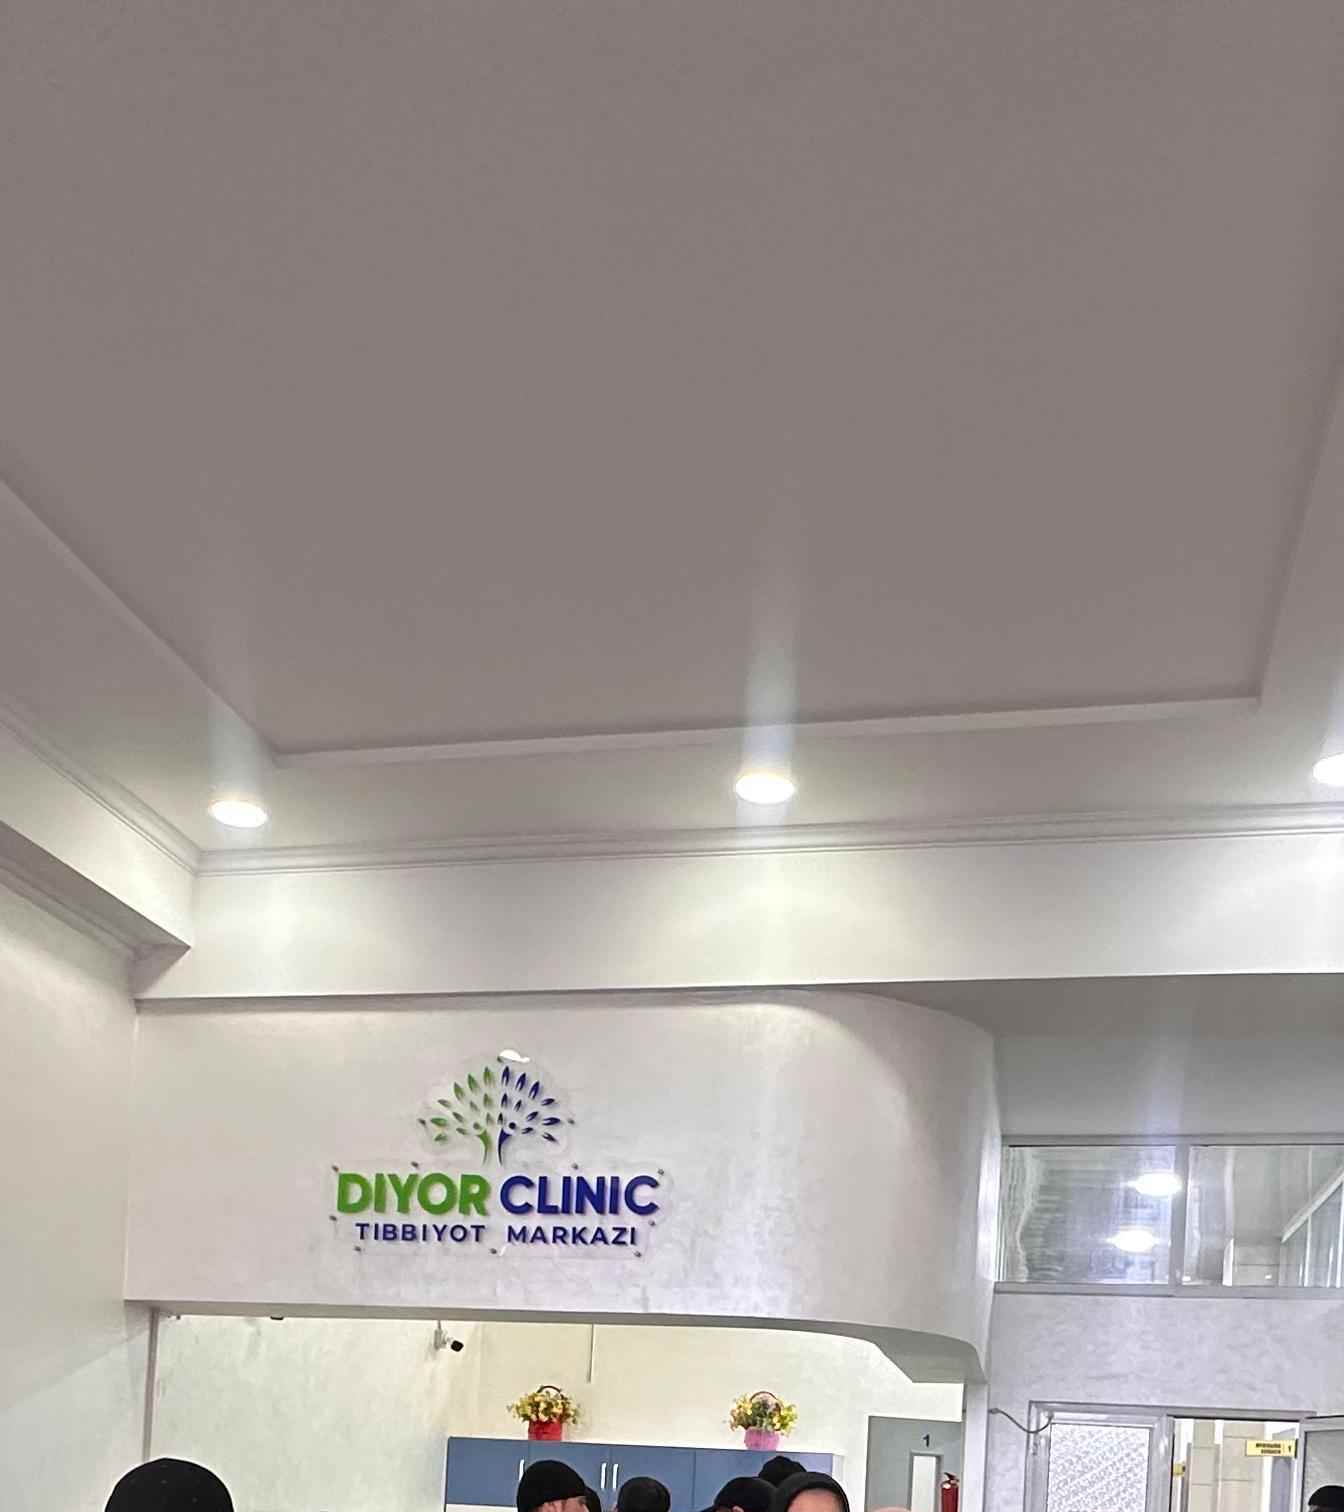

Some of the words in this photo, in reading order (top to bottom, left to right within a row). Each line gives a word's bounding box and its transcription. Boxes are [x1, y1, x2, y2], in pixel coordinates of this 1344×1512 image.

[336, 1172, 490, 1216] DIYOR
[500, 1175, 660, 1216] CLINIC
[356, 1223, 485, 1244] TIBBIYOT
[507, 1226, 637, 1246] MARKAZI
[922, 1433, 930, 1448] 1
